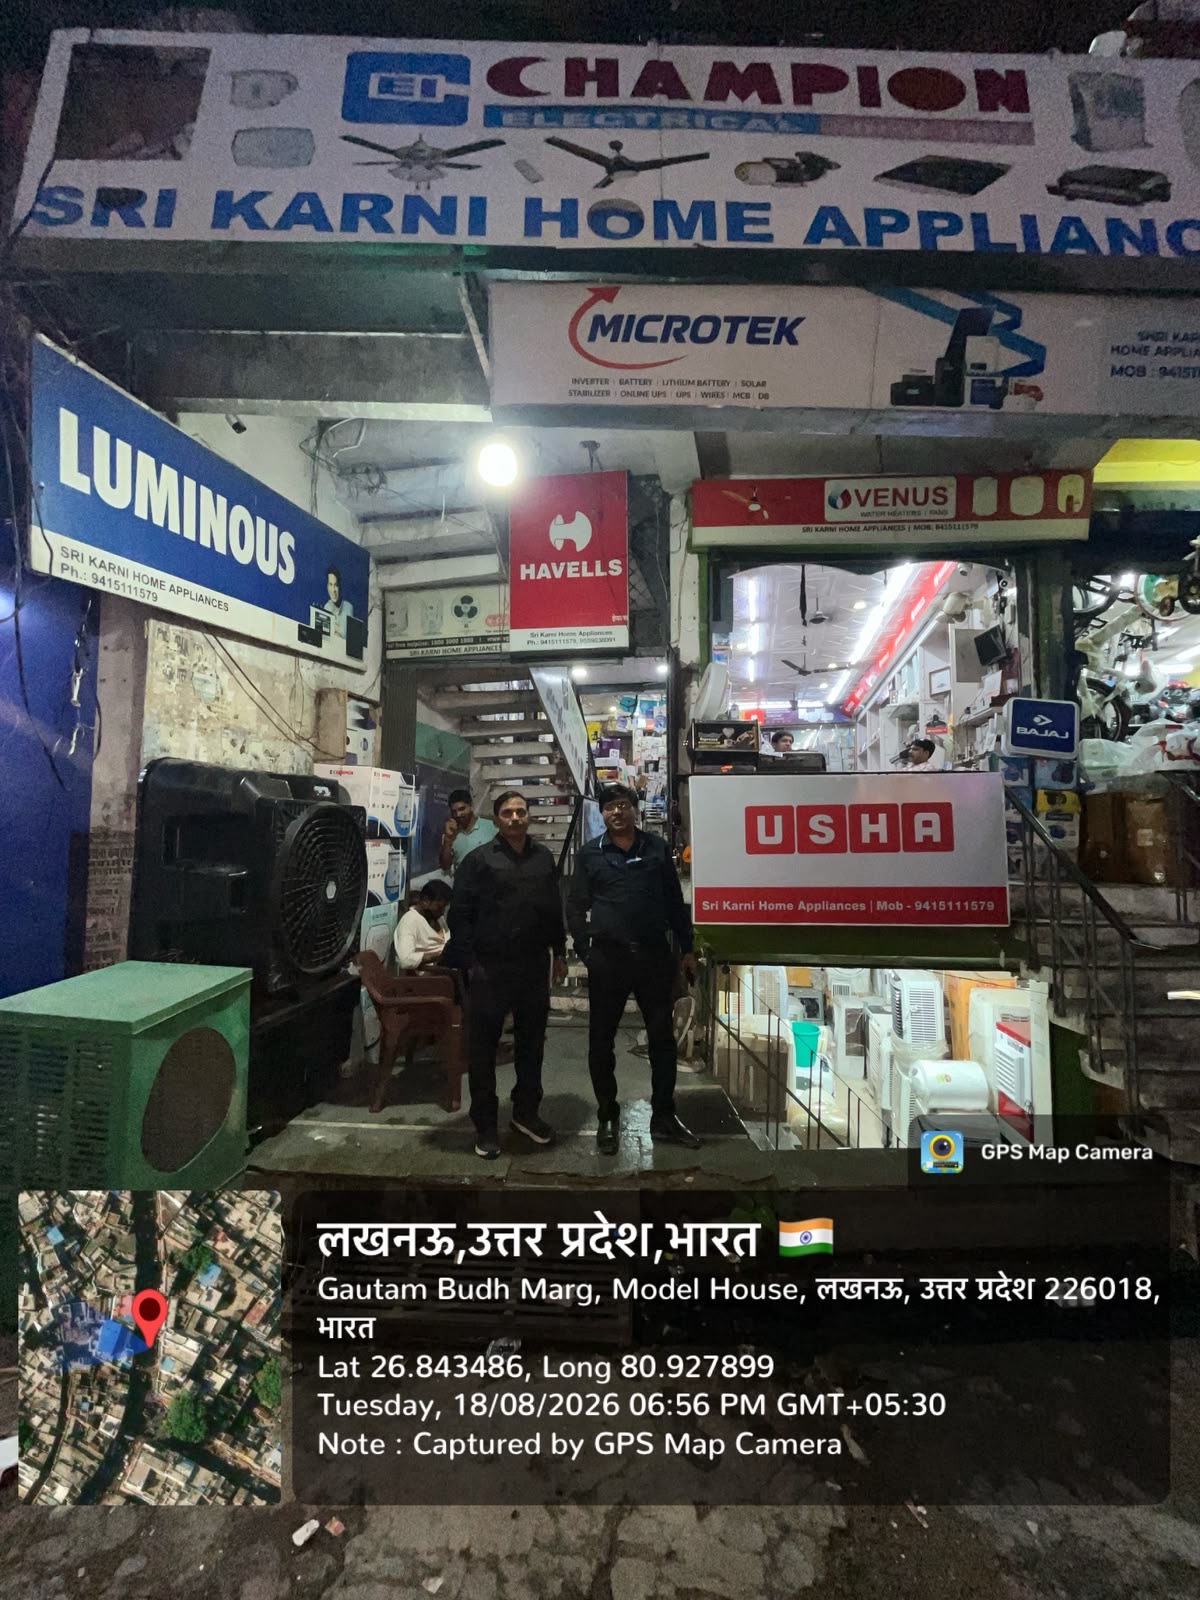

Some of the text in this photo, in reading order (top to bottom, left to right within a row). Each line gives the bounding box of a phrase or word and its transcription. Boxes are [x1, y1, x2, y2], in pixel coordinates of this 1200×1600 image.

[486, 56, 1031, 113] CHAMPION
[34, 186, 177, 229] SRI
[211, 190, 487, 237] KARNI
[523, 196, 774, 243] HOME
[587, 314, 806, 346] MICROTEK
[1110, 345, 1150, 356] HOME
[571, 377, 767, 388] INVERTER BATTERY LITHIUM BATTERY SOLAR
[568, 389, 770, 400] STABILIZER ONLINE UPS UPS WIRES MCB DB
[59, 407, 295, 585] LUMINOUS
[854, 486, 949, 507] VENUS
[860, 510, 886, 518] WATER
[814, 525, 837, 533] KARNI
[862, 524, 906, 532] APPLIANCES
[520, 559, 622, 580] HAVELLS
[60, 546, 229, 612] SRI KARNI HOME APPLIANCES
[91, 573, 158, 602] 9415111579
[578, 630, 613, 638] Appliances
[463, 645, 502, 653] APPLIANCES
[1016, 726, 1069, 739] BAJAJ
[756, 812, 942, 846] USHA
[702, 900, 719, 911] Sri
[722, 900, 755, 911] Karni
[759, 900, 794, 911] Home
[797, 900, 866, 914] Appliances
[877, 900, 903, 911] Mob
[914, 900, 996, 911] 9415111579
